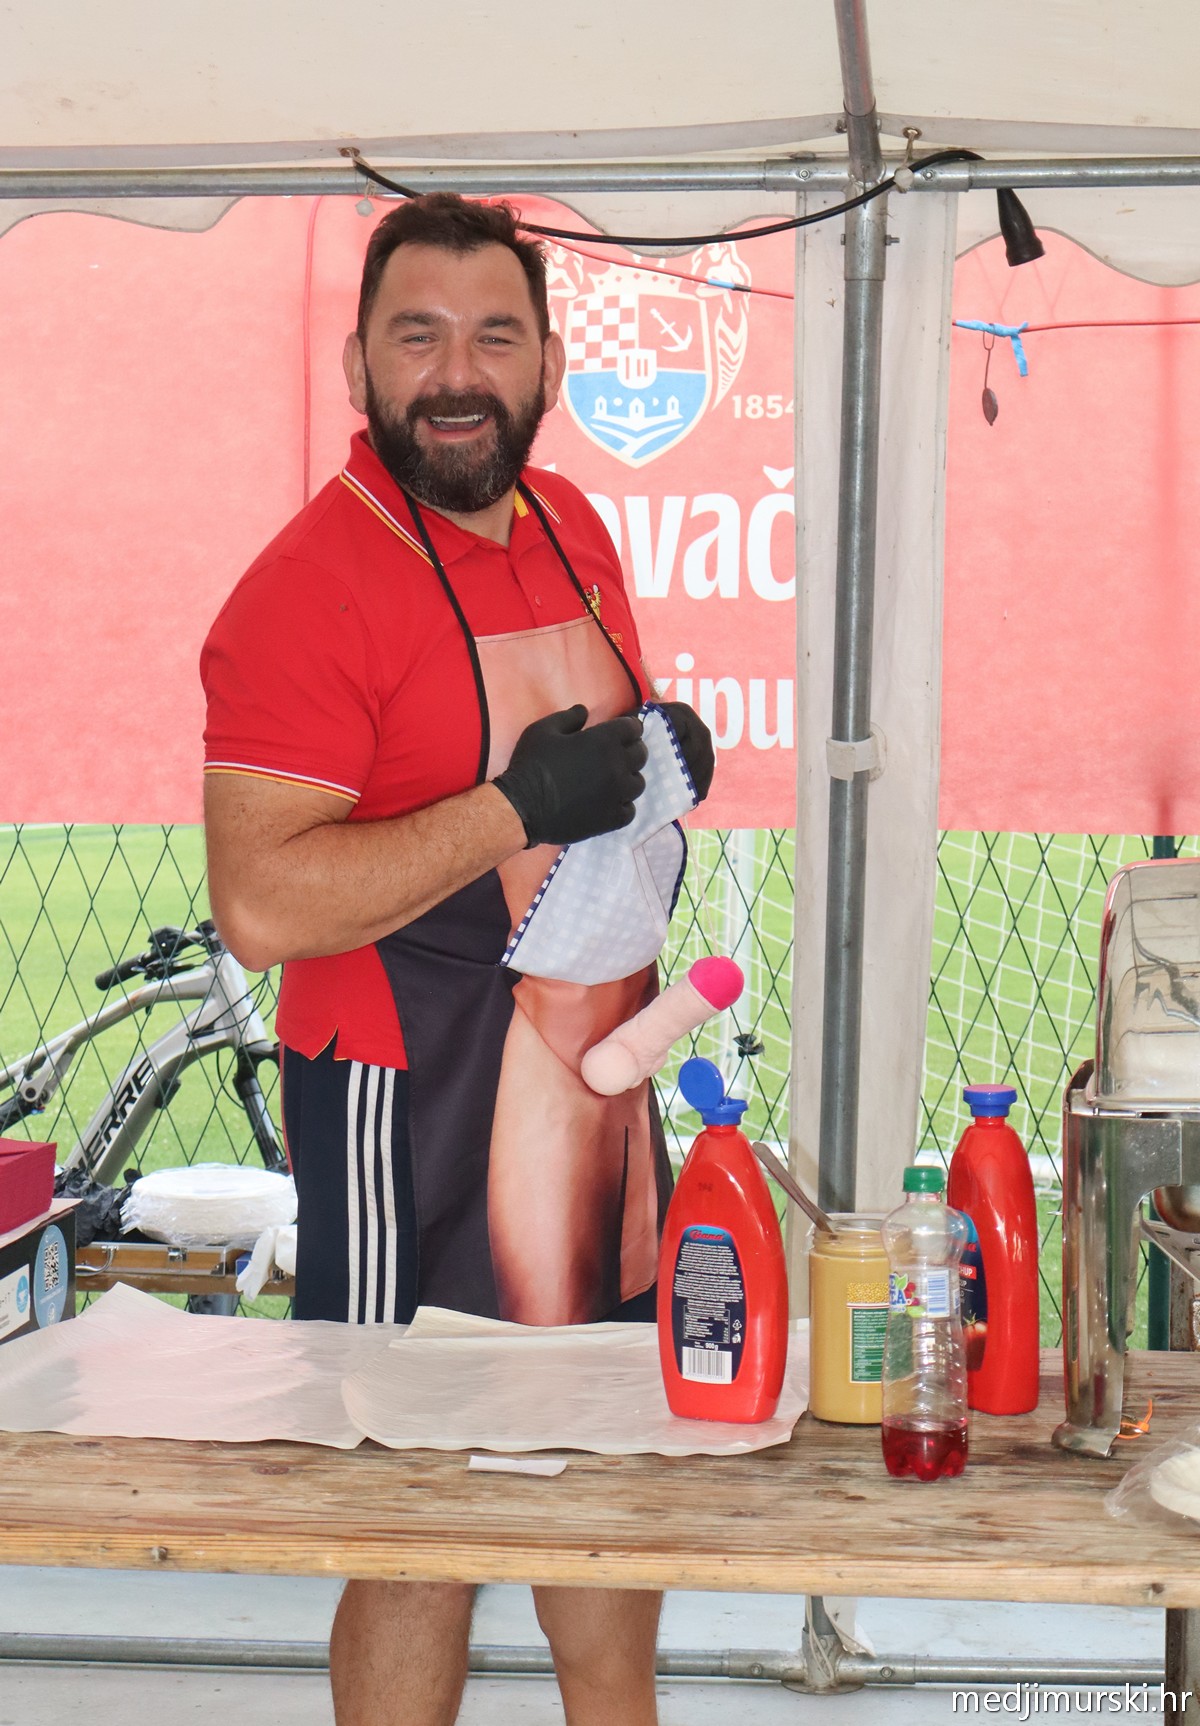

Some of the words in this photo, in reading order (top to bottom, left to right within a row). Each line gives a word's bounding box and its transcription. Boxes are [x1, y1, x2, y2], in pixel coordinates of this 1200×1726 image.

[584, 465, 796, 601] vač
[654, 652, 794, 767] ipu
[78, 1057, 155, 1171] ERRE
